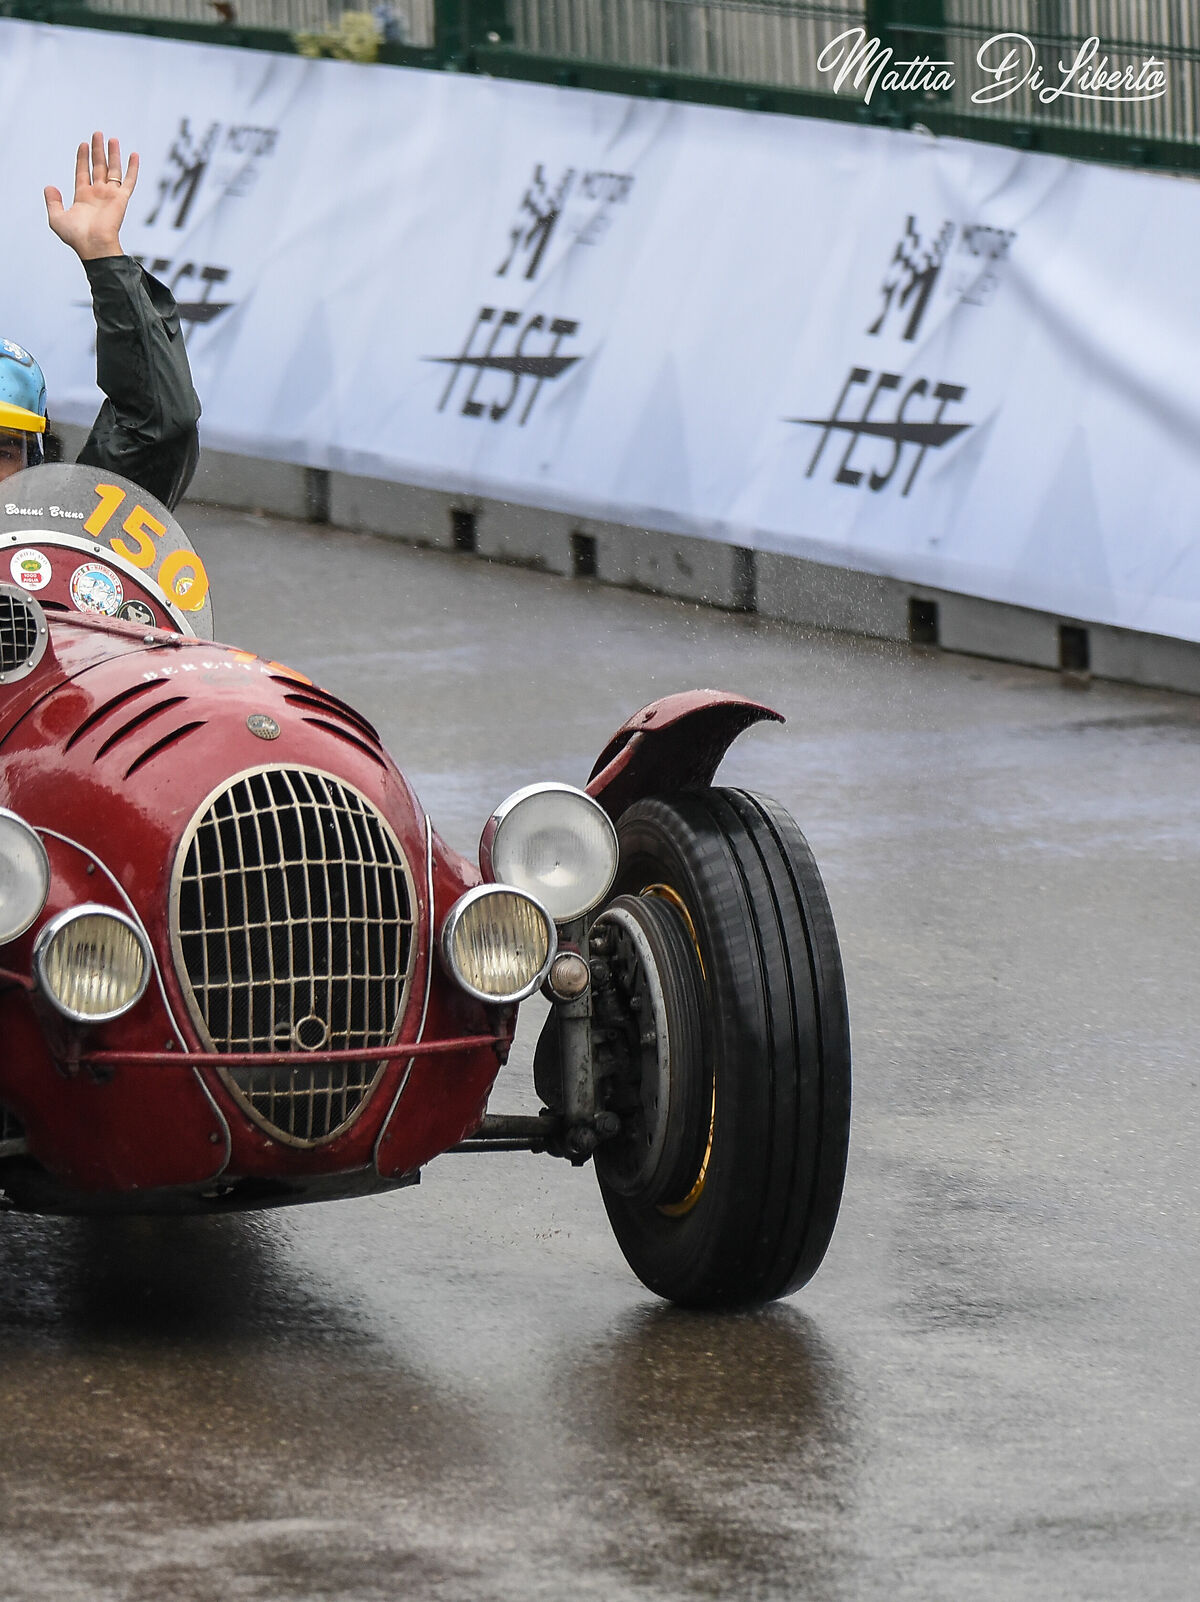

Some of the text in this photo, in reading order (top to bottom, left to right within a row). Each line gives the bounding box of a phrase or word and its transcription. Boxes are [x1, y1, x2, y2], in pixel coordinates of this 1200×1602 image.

[5, 503, 85, 520] Bonini Bruno
[83, 483, 209, 611] 150
